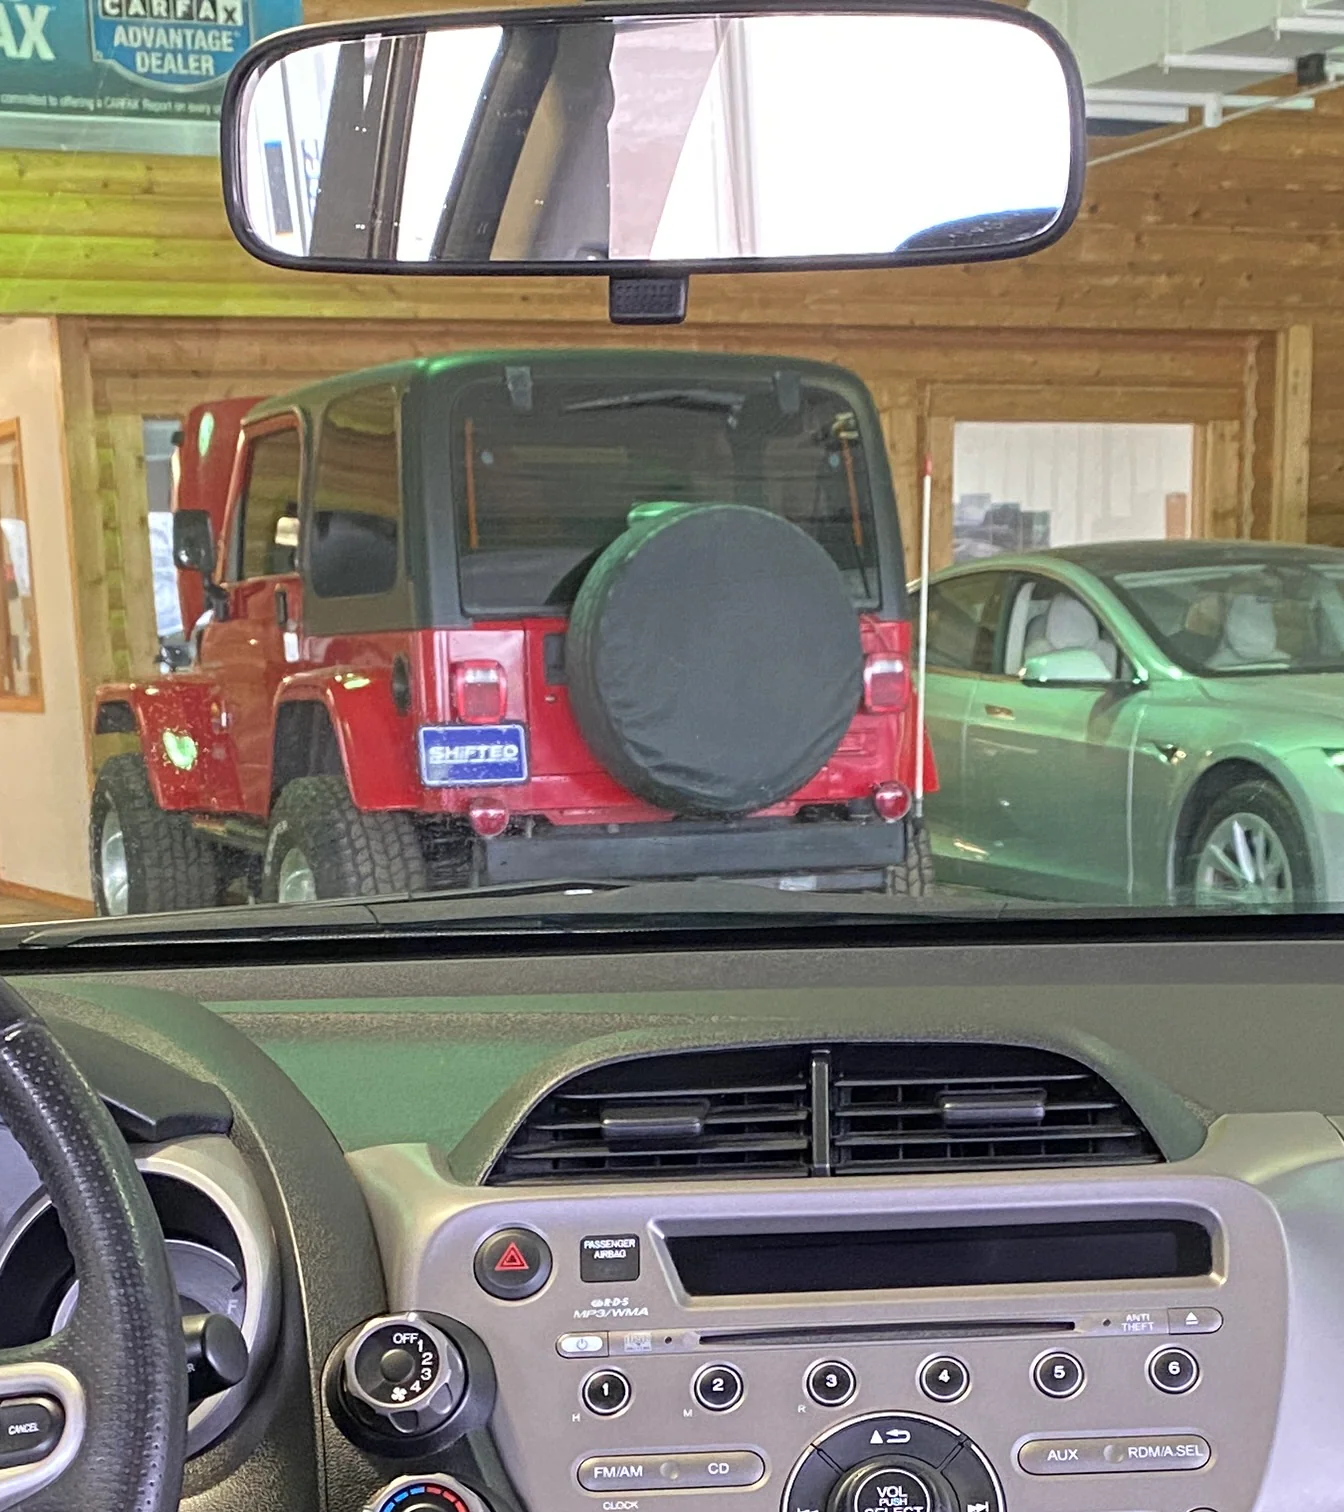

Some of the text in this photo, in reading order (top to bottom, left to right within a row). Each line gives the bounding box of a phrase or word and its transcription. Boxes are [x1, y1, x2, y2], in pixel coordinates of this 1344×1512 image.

[104, 0, 240, 25] CARFAX
[114, 24, 236, 52] ADVANTAGE
[135, 52, 216, 76] DEALER
[429, 745, 519, 760] SHIFTED
[584, 1238, 636, 1250] PASSENGER
[594, 1249, 627, 1260] AIRBAG
[227, 1299, 240, 1314] F
[573, 1307, 649, 1319] MP3/WMA
[1126, 1313, 1151, 1322] ANTI
[1121, 1321, 1155, 1332] THEFT
[393, 1332, 419, 1344] OFF
[417, 1339, 424, 1352] 1
[421, 1352, 433, 1365] 2
[420, 1367, 432, 1380] 3
[1054, 1365, 1066, 1379] 5
[1168, 1361, 1181, 1375] 6
[825, 1374, 838, 1388] 3
[938, 1369, 951, 1383] 4
[410, 1380, 422, 1392] 4
[601, 1383, 610, 1397] 1
[712, 1377, 725, 1392] 2
[684, 1409, 693, 1417] M
[798, 1405, 807, 1413] R
[572, 1414, 581, 1422] H
[8, 1422, 40, 1436] CANCEL
[1047, 1449, 1079, 1461] AUX
[1128, 1444, 1204, 1459] RDM/A.SEL
[594, 1465, 643, 1479] FM/AM
[707, 1462, 730, 1475] CD
[876, 1486, 908, 1498] VOL
[602, 1500, 639, 1511] CLOCK
[879, 1498, 908, 1507] PUSH
